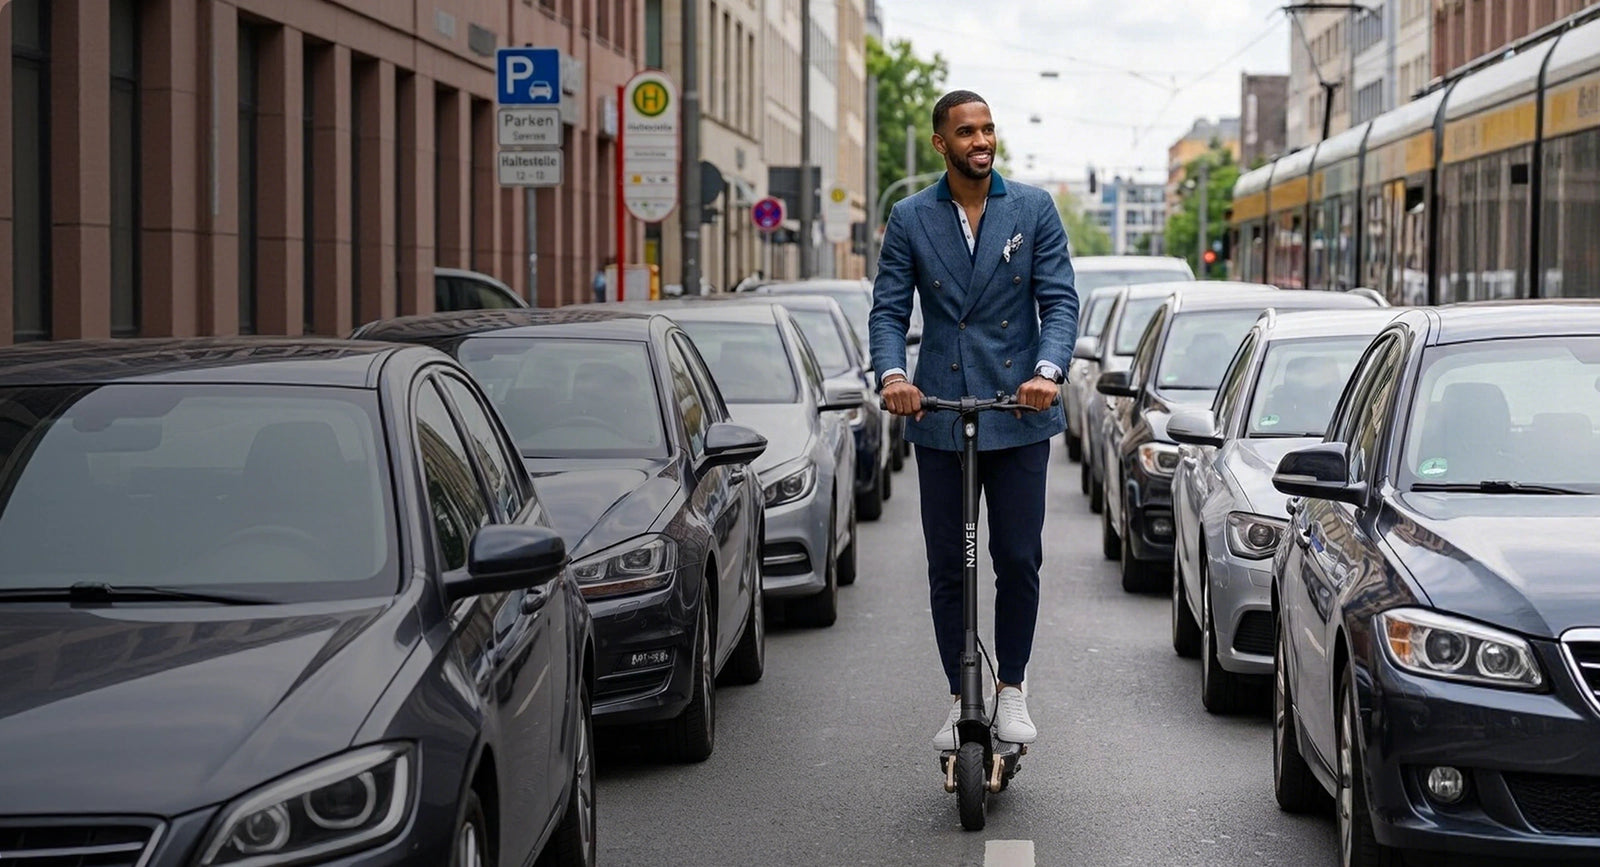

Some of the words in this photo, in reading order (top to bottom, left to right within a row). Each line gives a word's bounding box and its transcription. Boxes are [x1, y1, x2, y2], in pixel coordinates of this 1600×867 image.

[505, 55, 534, 95] P
[642, 89, 659, 110] H
[504, 113, 554, 128] Parken
[501, 155, 557, 167] Haltestelle
[965, 522, 976, 568] NAVEE
